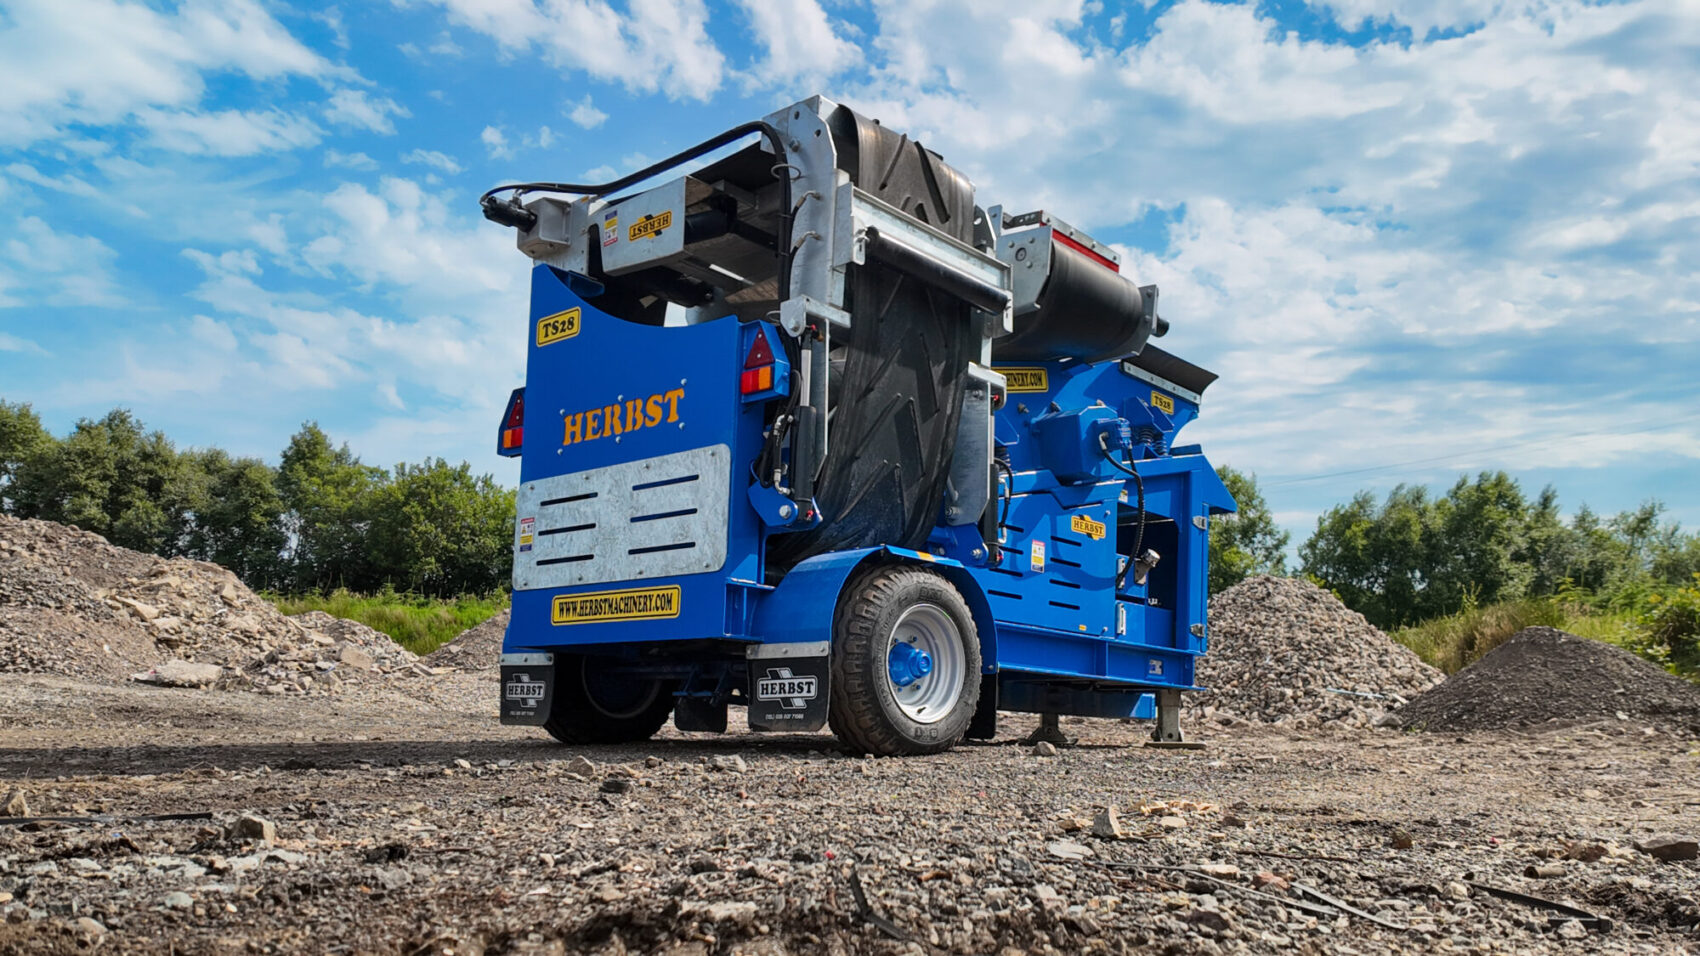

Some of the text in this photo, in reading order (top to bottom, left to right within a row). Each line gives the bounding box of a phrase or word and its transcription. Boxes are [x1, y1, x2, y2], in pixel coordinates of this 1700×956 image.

[631, 214, 670, 238] HERBST
[543, 316, 575, 339] TS28
[1154, 395, 1172, 410] TS28
[562, 387, 685, 446] HERBST
[1073, 519, 1104, 535] HERBST
[558, 592, 673, 619] WWW.HERBSTMACHINERY.COM
[508, 685, 543, 696] HERBST
[760, 681, 814, 696] HERBST
